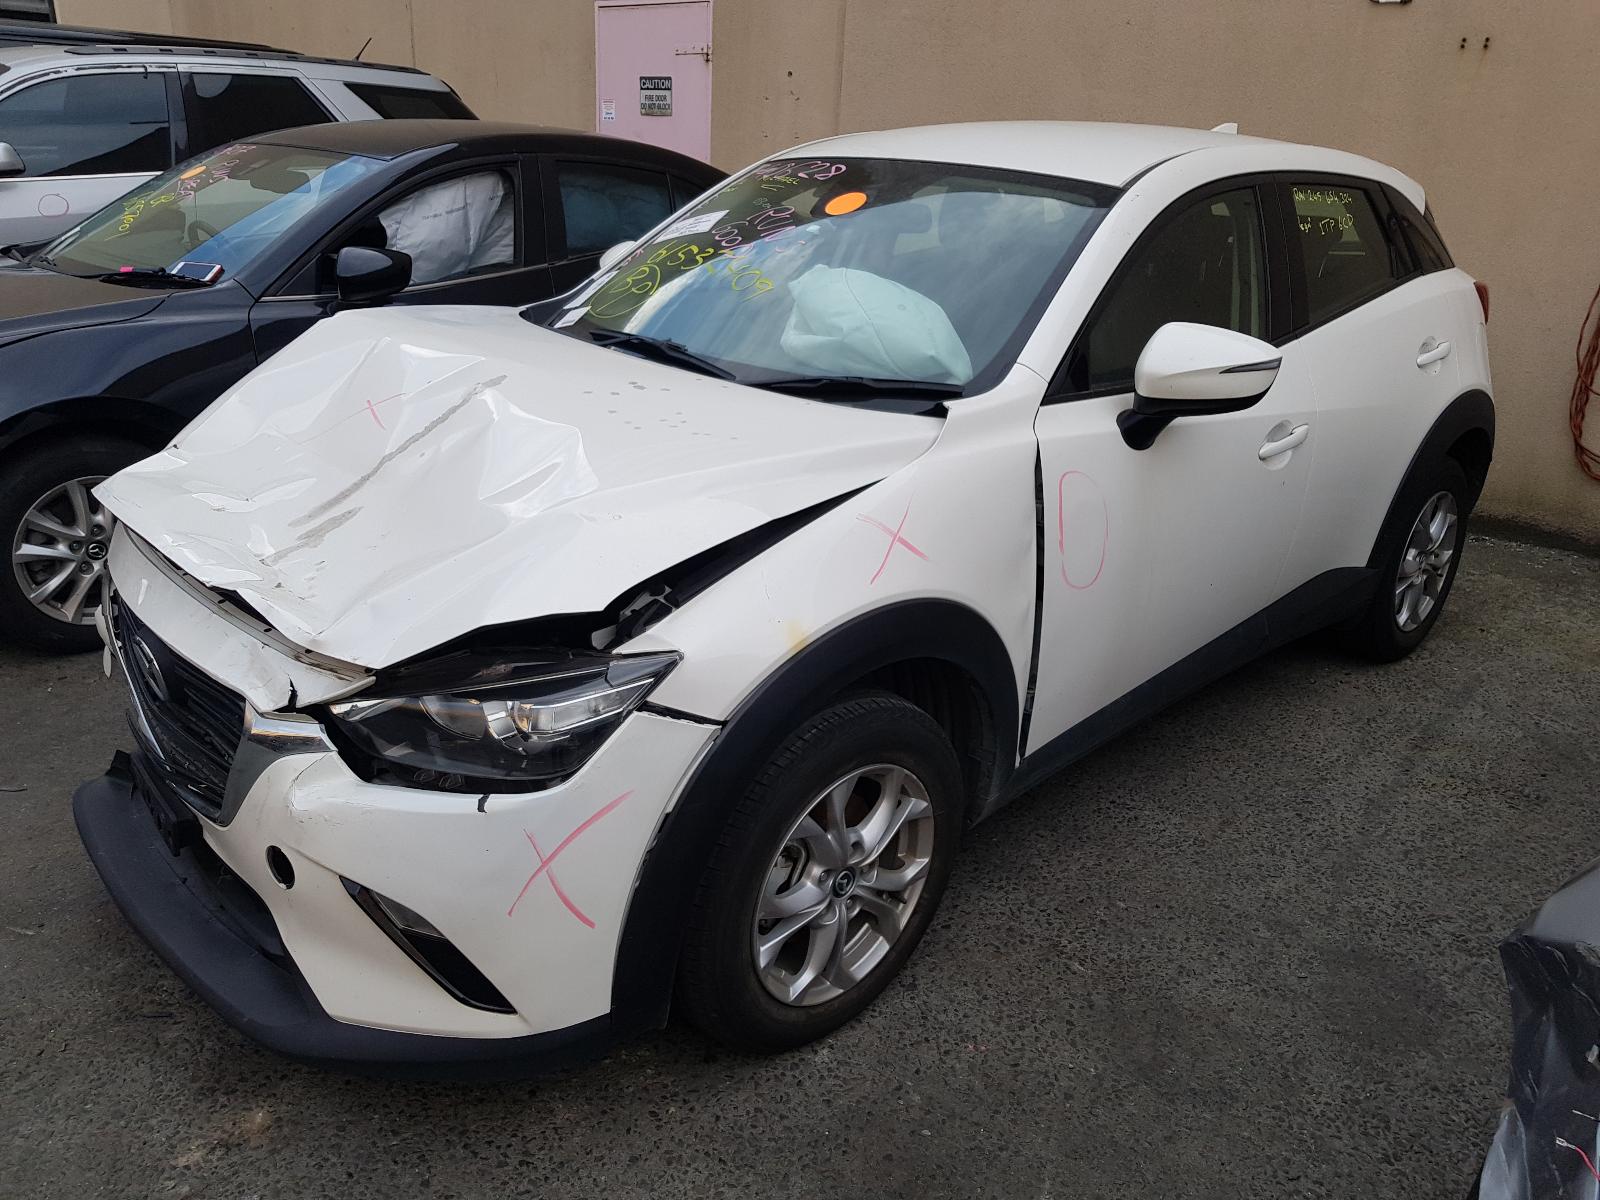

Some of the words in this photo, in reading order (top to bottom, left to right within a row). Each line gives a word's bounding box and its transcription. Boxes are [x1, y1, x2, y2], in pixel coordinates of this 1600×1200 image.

[641, 79, 671, 89] CAUTION
[644, 94, 655, 102] FIRE
[655, 94, 667, 102] DOOR
